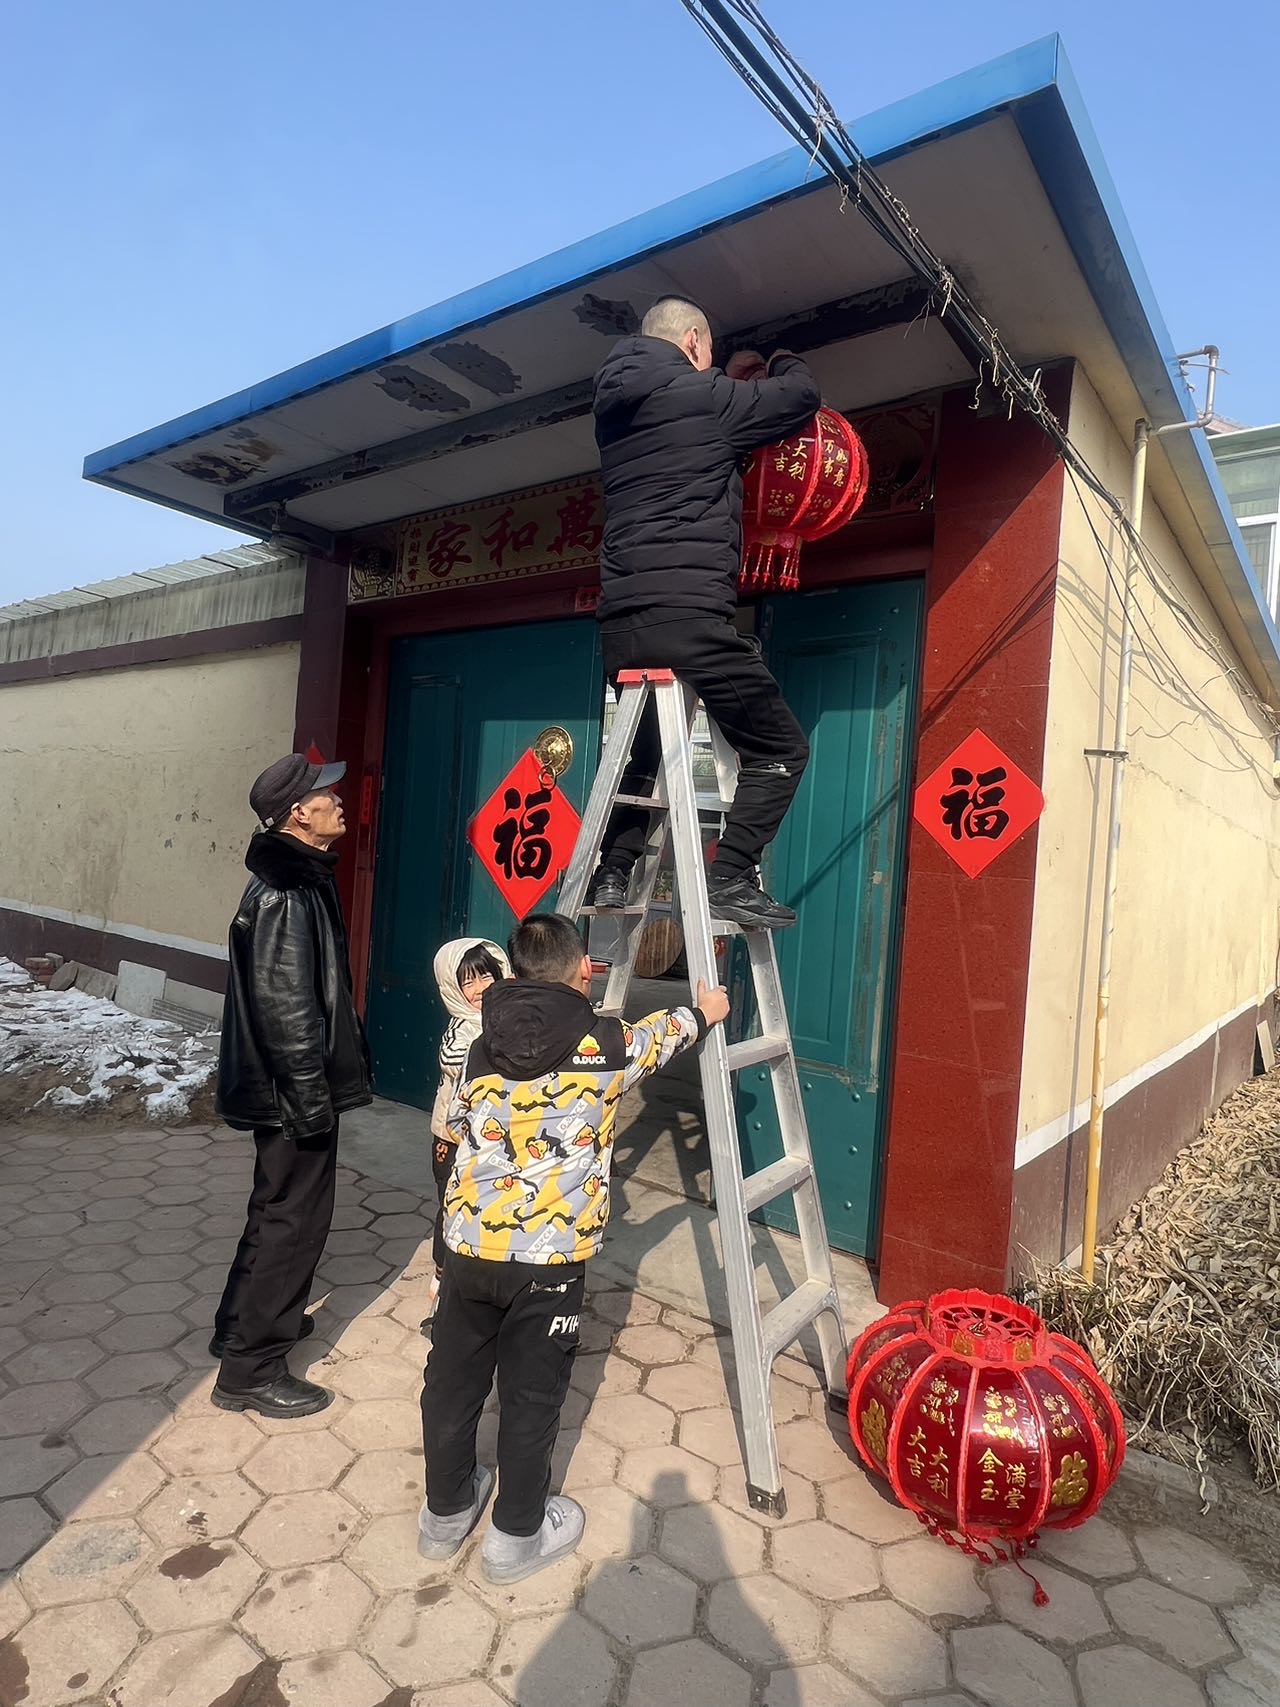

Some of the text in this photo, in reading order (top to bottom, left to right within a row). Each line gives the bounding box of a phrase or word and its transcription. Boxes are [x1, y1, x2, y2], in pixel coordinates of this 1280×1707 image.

[788, 442, 808, 481] 大利
[824, 439, 836, 479] 万事
[939, 766, 1010, 841] 福
[493, 787, 553, 880] 福
[573, 1055, 606, 1064] G.DUCK
[907, 1426, 928, 1478] 大吉
[928, 1446, 950, 1499] 大利
[976, 1447, 1004, 1501] 金玉
[1004, 1463, 1027, 1509] 满堂
